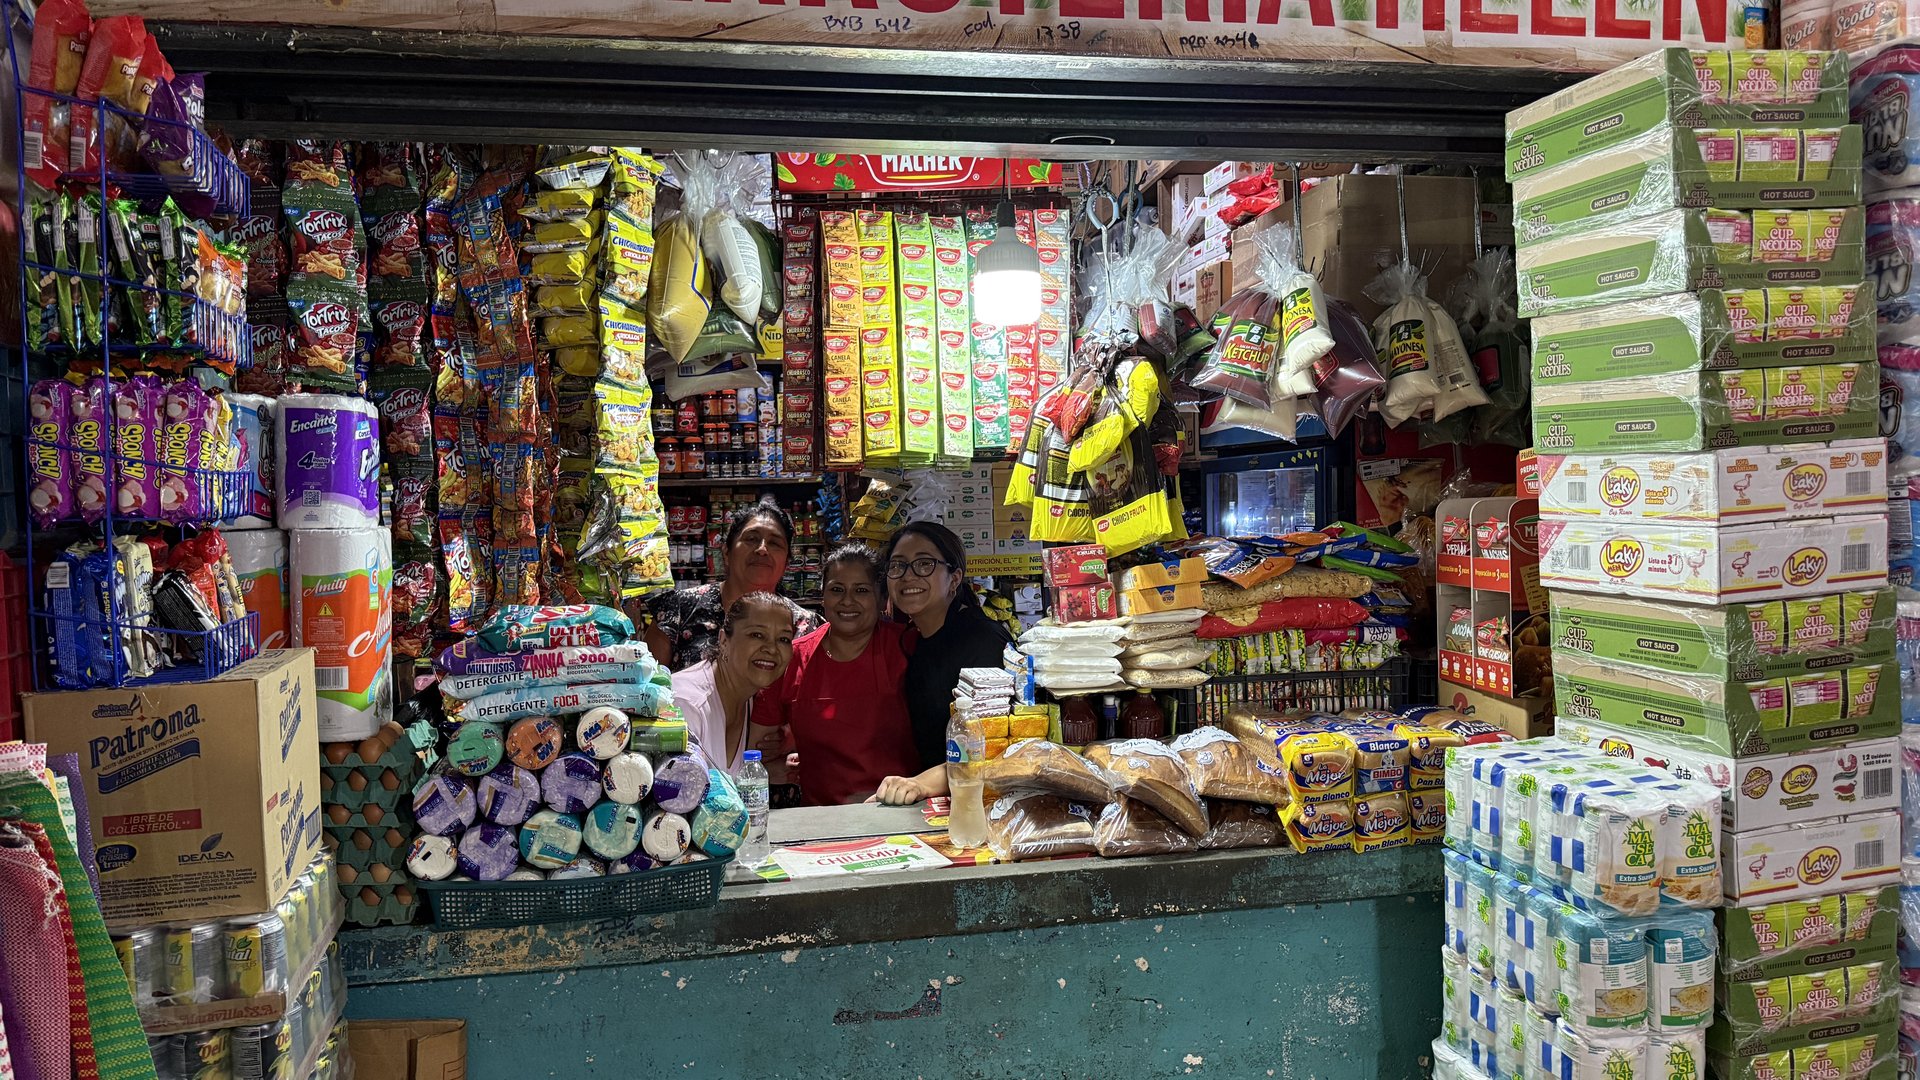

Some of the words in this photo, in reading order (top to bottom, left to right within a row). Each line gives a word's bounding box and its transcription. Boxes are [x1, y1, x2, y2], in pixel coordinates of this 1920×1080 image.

[875, 16, 912, 33] 542
[1834, 2, 1875, 37] Scott
[1784, 18, 1817, 49] Scott
[1747, 69, 1770, 81] CUP
[1738, 80, 1778, 93] NOODLES
[1755, 112, 1773, 121] HOT
[1774, 112, 1801, 121] SAUCE
[1586, 122, 1600, 134] HOT
[1599, 117, 1621, 131] SAUCE
[1520, 143, 1539, 160] CUP
[1512, 154, 1546, 175] NOODLES
[1593, 198, 1607, 208] HOT
[1607, 193, 1627, 205] SAUCE
[1690, 190, 1709, 199] CUP
[1763, 190, 1782, 199] HOT
[1783, 190, 1811, 199] SAUCE
[312, 228, 348, 244] TACOS
[1769, 228, 1794, 240] CUP
[1759, 239, 1803, 251] NOODLES
[1600, 274, 1614, 283] HOT
[1614, 270, 1636, 281] SAUCE
[1771, 271, 1790, 280] HOT
[1790, 270, 1817, 279] SAUCE
[1784, 304, 1809, 316] CUP
[1775, 315, 1816, 328] NOODLES
[314, 322, 349, 338] TACOS
[764, 331, 782, 341] NID
[1223, 343, 1270, 364] KETCHUP
[1615, 348, 1629, 356] HOT
[1629, 345, 1650, 354] SAUCE
[1786, 348, 1805, 357] HOT
[1805, 347, 1831, 356] SAUCE
[1546, 353, 1565, 366] CUP
[1538, 363, 1572, 379] NOODLES
[1782, 384, 1807, 396] CUP
[289, 415, 337, 434] Encanto
[1547, 425, 1567, 437] CUP
[1617, 423, 1631, 431] HOT
[1631, 422, 1652, 430] SAUCE
[1786, 427, 1804, 435] HOT
[1804, 425, 1831, 434] SAUCE
[1717, 430, 1734, 439] CUP
[1541, 435, 1575, 448] NOODLES
[298, 450, 315, 469] 4
[1604, 476, 1637, 501] Laky
[1789, 471, 1823, 496] Laky
[1605, 543, 1640, 571] Laky
[1667, 554, 1673, 565] 3
[1789, 554, 1824, 580] Laky
[303, 578, 348, 597] Amity
[1803, 615, 1826, 627] CUP
[549, 622, 598, 637] ULTRA
[1566, 626, 1587, 640] CUP
[1794, 625, 1834, 640] NOODLES
[1558, 635, 1594, 653] NOODLES
[1640, 640, 1653, 648] HOT
[1653, 642, 1675, 651] SAUCE
[467, 662, 516, 675] MULTIUSOS
[1809, 659, 1825, 668] HOT
[1825, 656, 1851, 665] SAUCE
[456, 673, 525, 690] DETERGENTE
[479, 700, 546, 717] DETERGENTE
[553, 695, 580, 707] FOCA
[1572, 693, 1593, 708] CUP
[1564, 702, 1601, 721] NOODLES
[1646, 711, 1660, 721] HOT
[1660, 714, 1682, 726] SAUCE
[88, 703, 201, 769] Patrona
[583, 717, 614, 743] MAX
[1813, 731, 1829, 739] HOT
[1830, 727, 1855, 737] SAUCE
[1369, 740, 1400, 751] Blanco
[1318, 763, 1328, 772] La
[1372, 767, 1403, 780] BIMBO
[1305, 770, 1346, 785] Mejor
[1416, 777, 1434, 786] Pan
[1787, 770, 1812, 787] Laky
[1303, 794, 1322, 804] Pan
[1322, 791, 1350, 801] Blanco
[1375, 810, 1385, 818] La
[1428, 805, 1438, 813] La
[123, 814, 156, 825] LIBRE
[158, 813, 174, 822] DE
[1320, 813, 1332, 822] La
[107, 822, 182, 835] COLESTEROL
[1308, 820, 1348, 836] Mejor
[1363, 817, 1403, 833] Mejor
[1687, 823, 1711, 837] MA
[1364, 842, 1381, 852] Pan
[1381, 836, 1408, 848] Blanco
[1415, 837, 1432, 846] Pan
[1628, 831, 1652, 845] MA
[1694, 833, 1713, 846] SE
[1635, 842, 1654, 857] SE
[1686, 844, 1709, 858] CA
[178, 851, 235, 863] IDEALSA
[816, 848, 904, 866] CHILEMIX
[1625, 853, 1650, 867] CA
[103, 859, 129, 869] trans
[1804, 853, 1836, 879] Laky
[1680, 867, 1698, 875] Extra
[1619, 874, 1636, 882] Extra
[1803, 916, 1826, 928] CUP
[1809, 956, 1825, 964] HOT
[1826, 950, 1851, 961] SAUCE
[1807, 989, 1831, 1001] CUP
[1798, 998, 1839, 1012] NOODLES
[1812, 1030, 1829, 1039] HOT
[1829, 1026, 1856, 1036] SAUCE
[1670, 1052, 1692, 1065] MA
[1607, 1060, 1630, 1074] MA
[1678, 1062, 1696, 1075] SE
[1809, 1059, 1833, 1072] CUP
